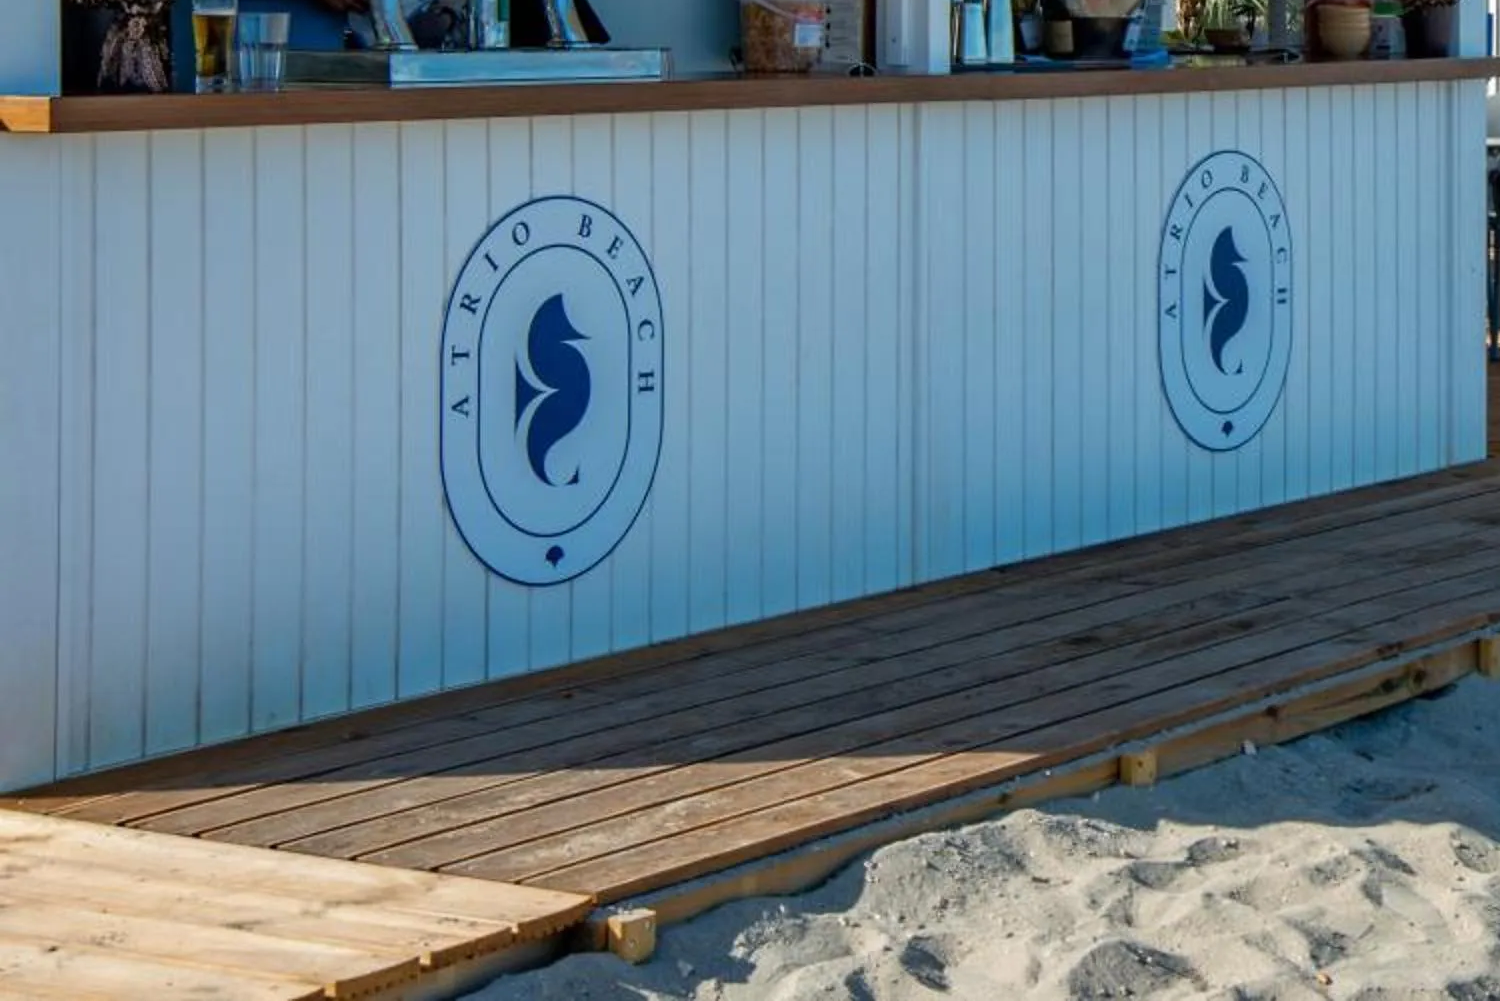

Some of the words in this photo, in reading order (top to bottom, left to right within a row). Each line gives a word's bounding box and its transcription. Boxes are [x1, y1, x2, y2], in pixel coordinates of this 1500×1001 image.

[451, 222, 532, 417] ATRIO
[577, 214, 655, 394] BEACH
[1165, 170, 1213, 318] ATRIO
[1240, 165, 1286, 304] BEACH
